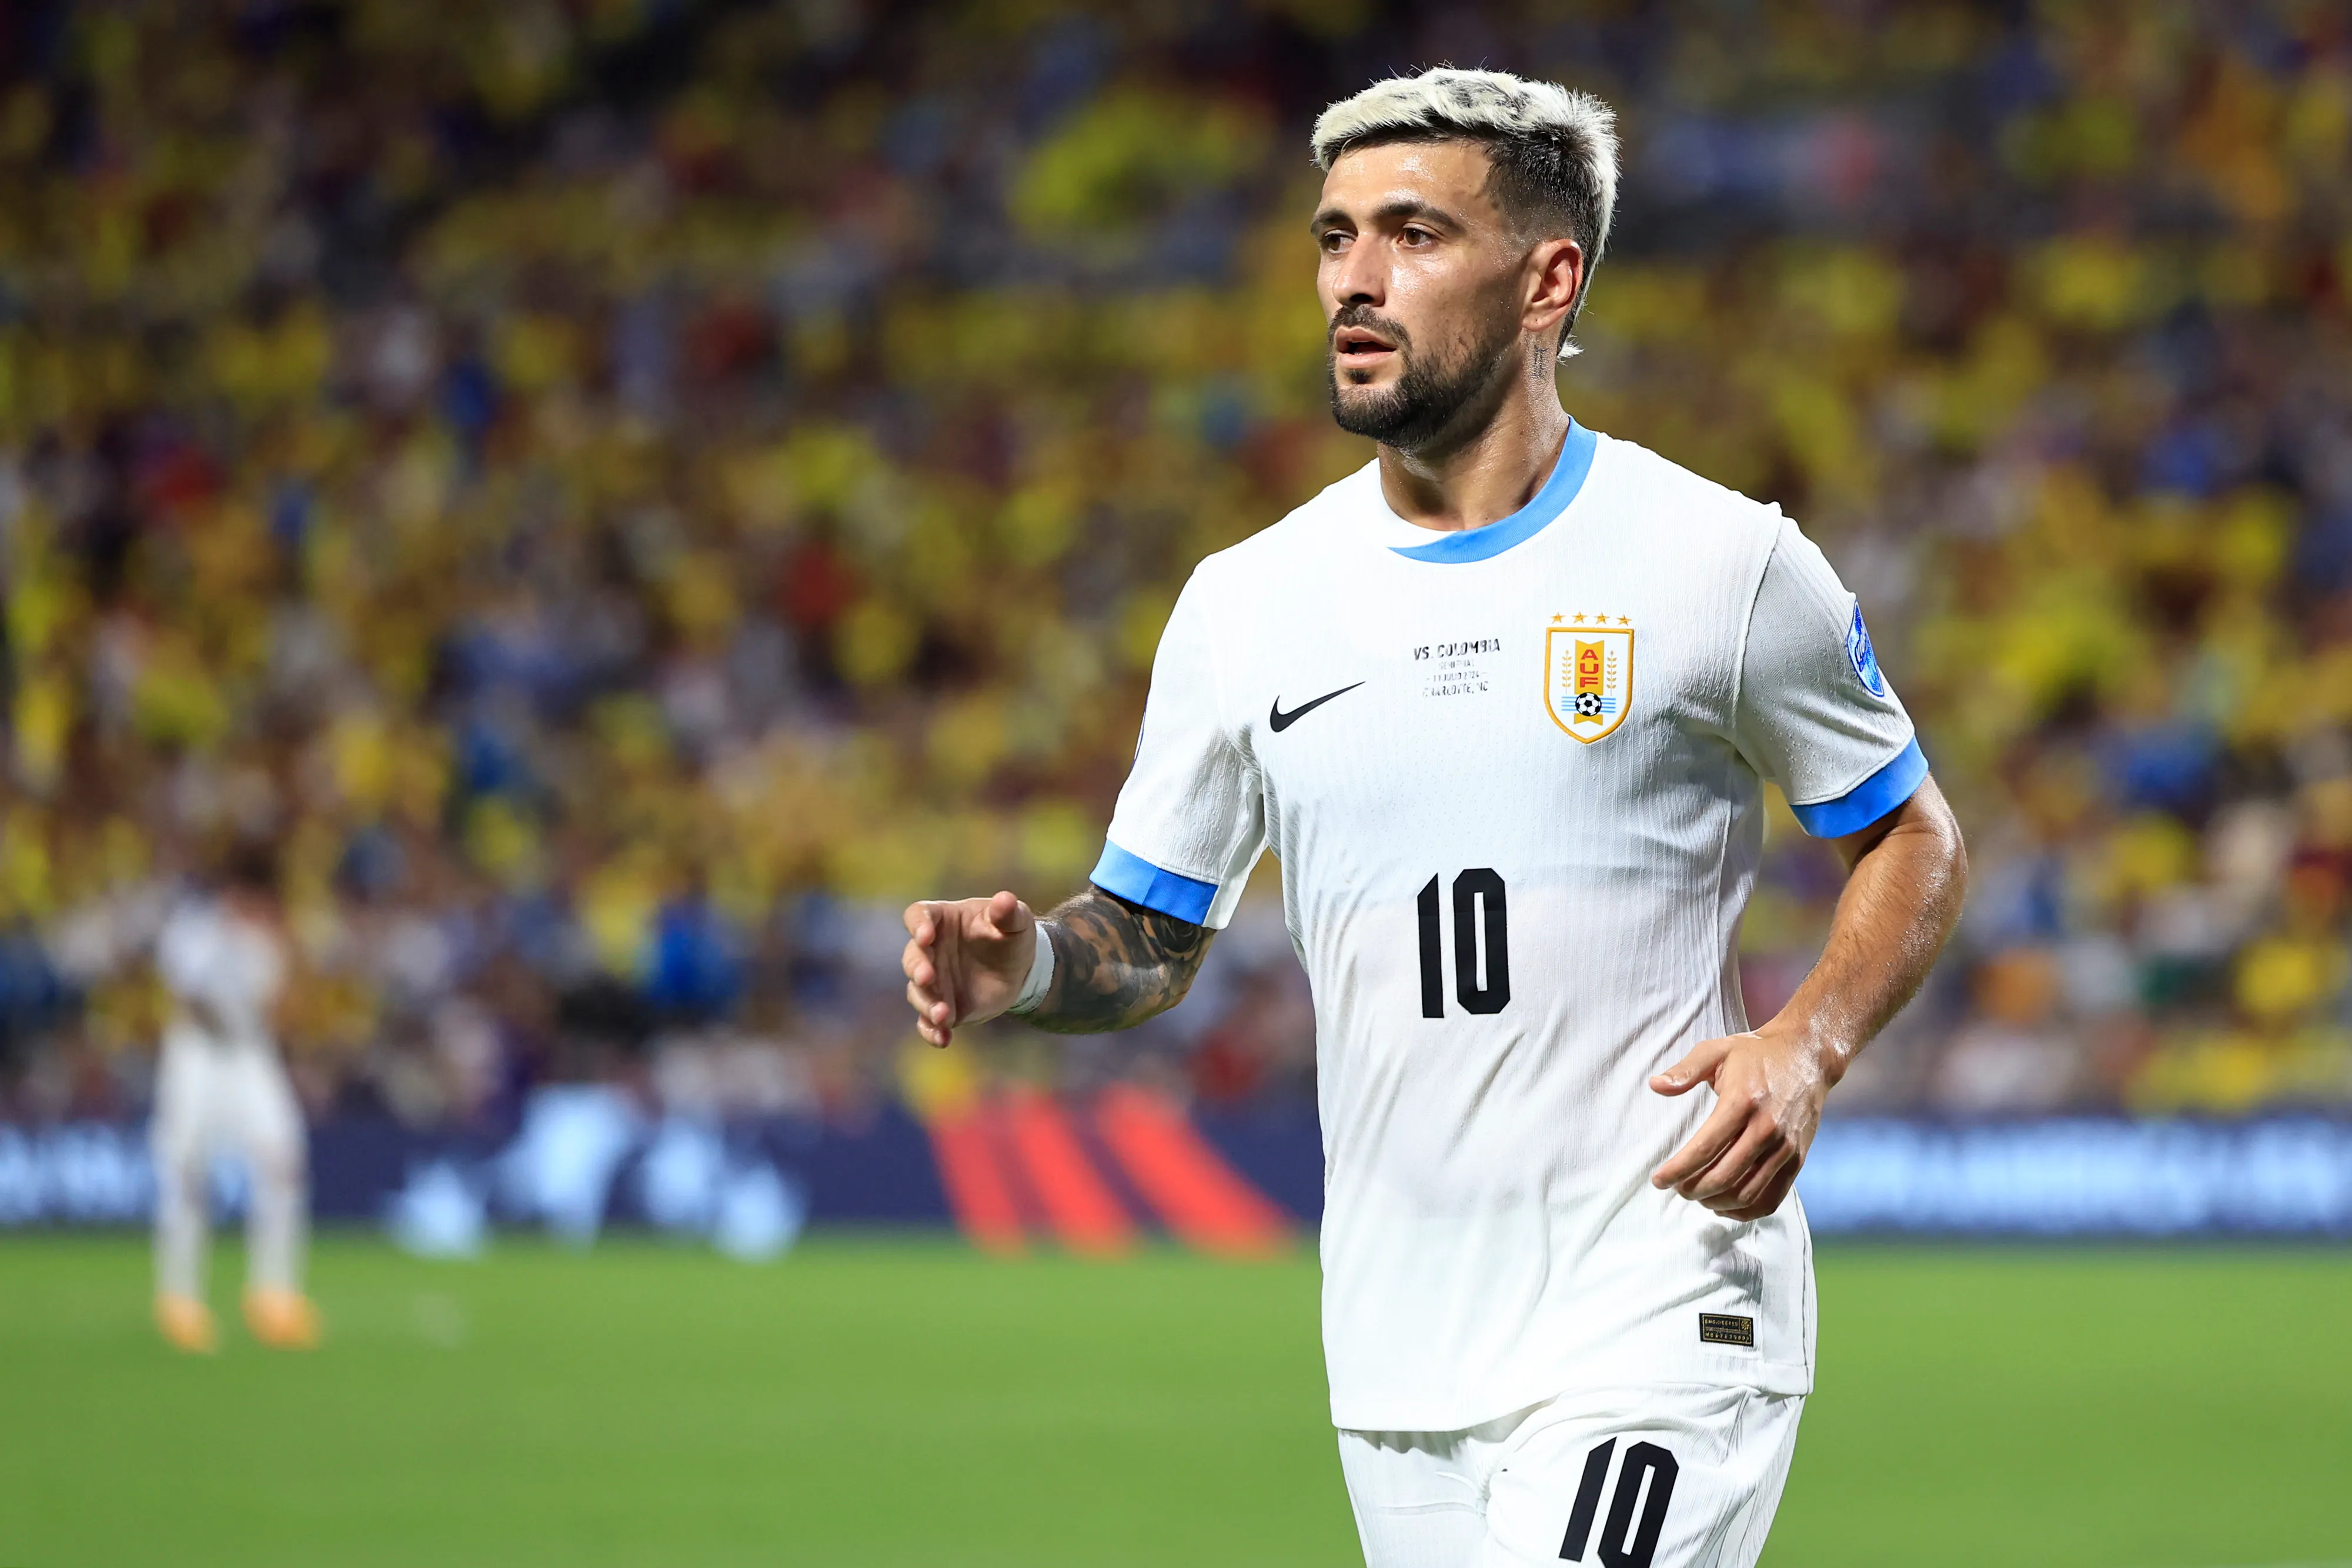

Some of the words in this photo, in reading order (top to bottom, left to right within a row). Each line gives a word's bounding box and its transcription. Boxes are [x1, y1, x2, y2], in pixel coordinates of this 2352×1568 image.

[1413, 646, 1433, 661] VS.
[1437, 638, 1501, 658] COLOMBIA
[1438, 658, 1475, 670] SEMIFNAL
[1579, 648, 1599, 688] AUF
[1416, 868, 1511, 1019] 10
[1558, 1436, 1680, 1568] 10
